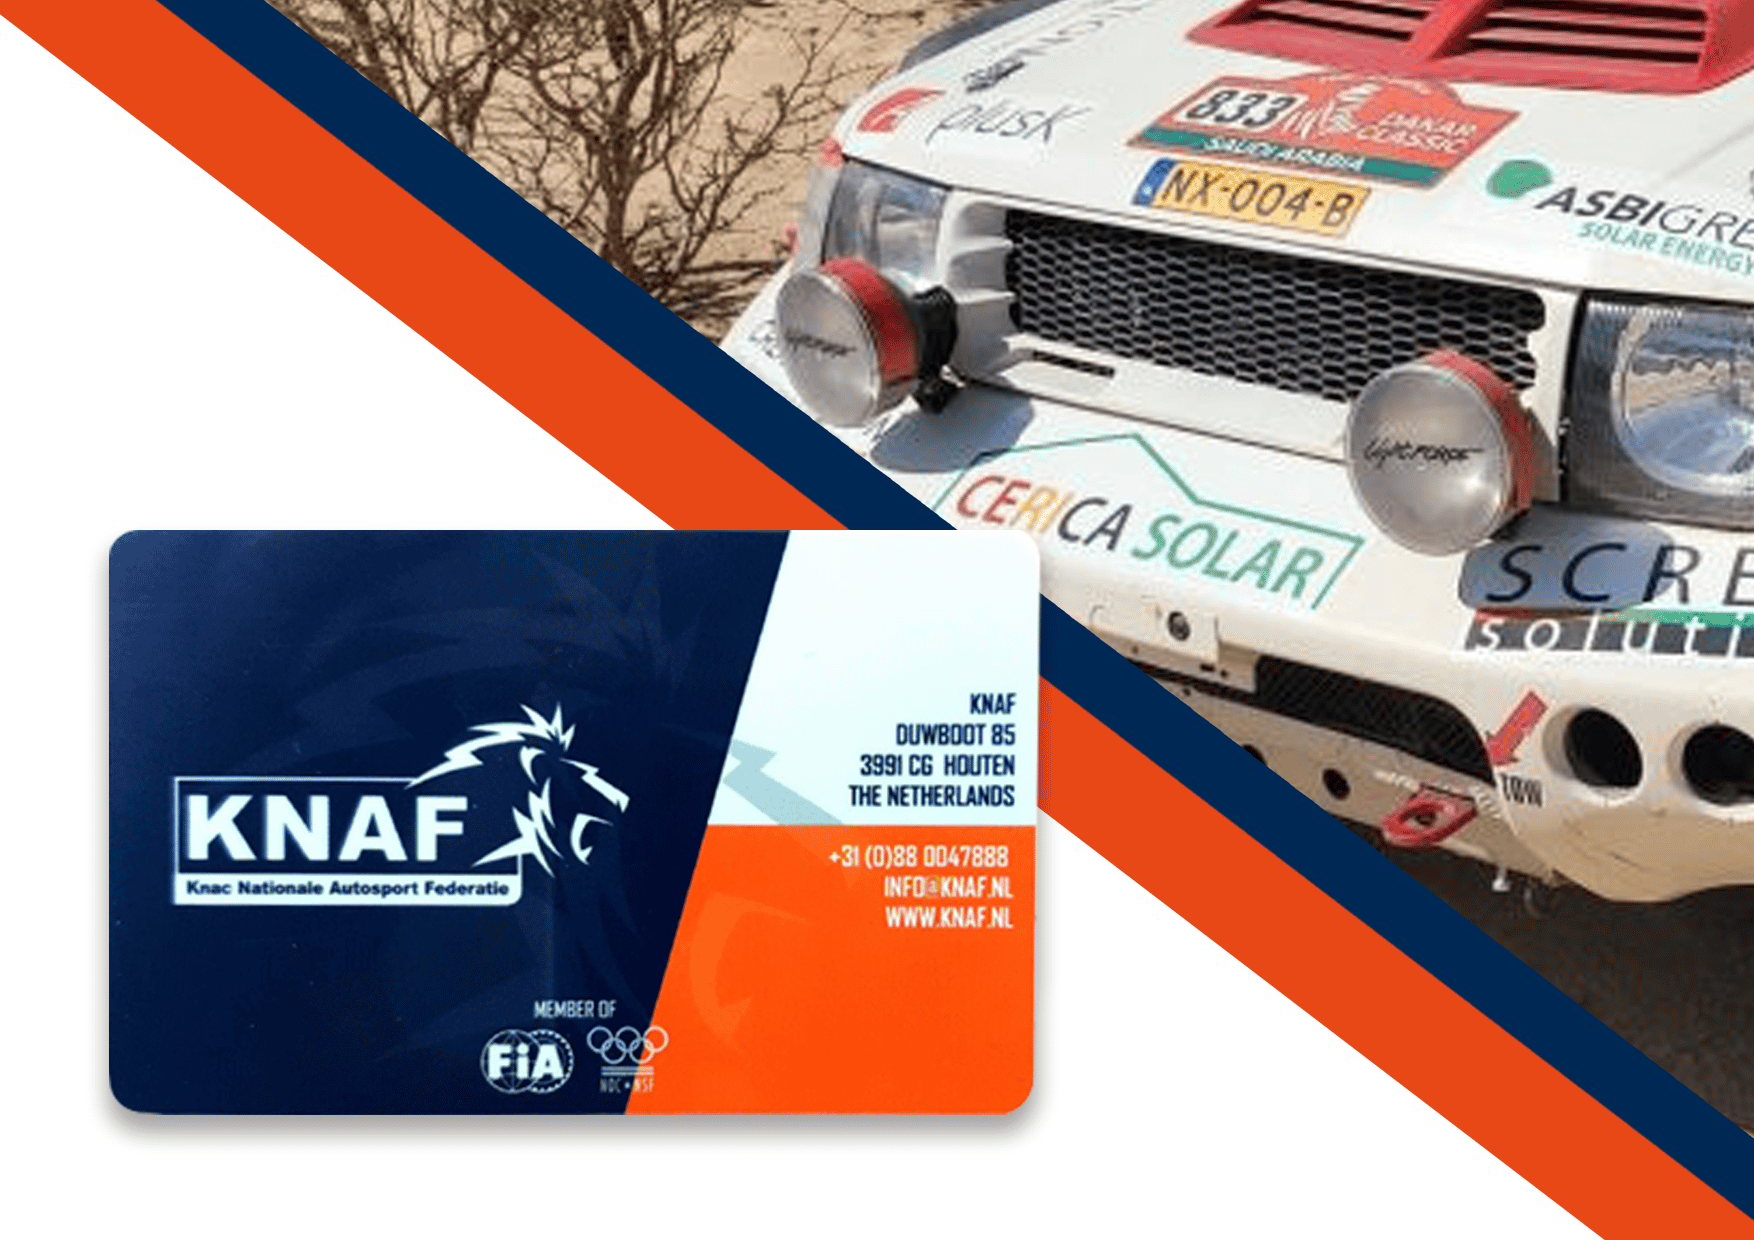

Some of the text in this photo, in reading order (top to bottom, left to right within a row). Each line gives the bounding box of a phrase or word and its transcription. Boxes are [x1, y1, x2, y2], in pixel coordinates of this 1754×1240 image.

[1185, 89, 1477, 137] 833 DAKAR
[1355, 124, 1468, 154] CLASSIC
[1578, 221, 1659, 254] SOLAR
[956, 474, 1325, 599] CERICA SOLAR
